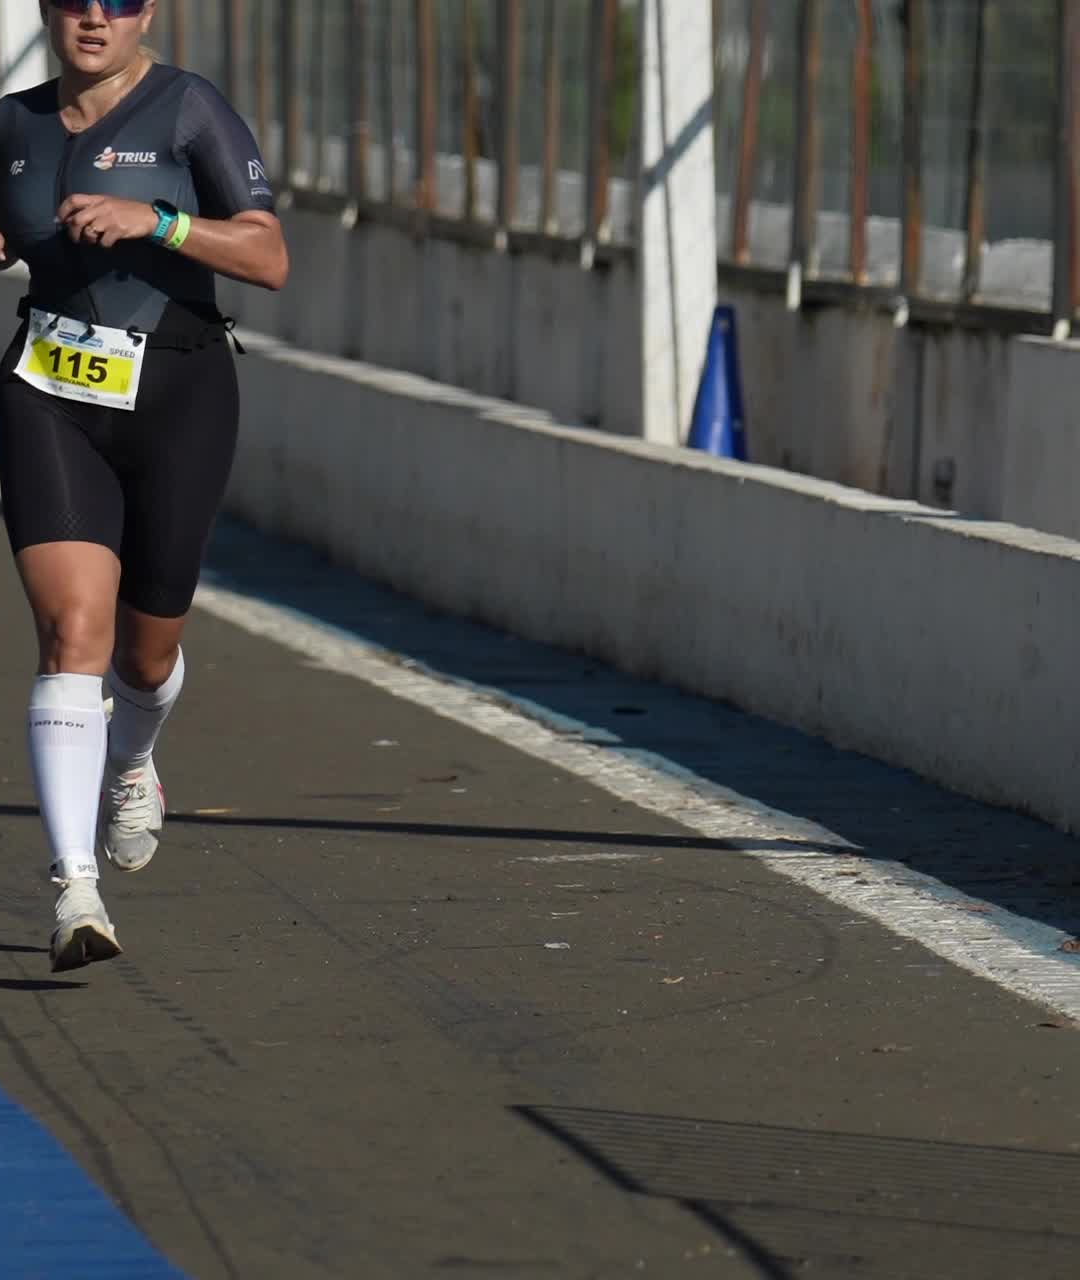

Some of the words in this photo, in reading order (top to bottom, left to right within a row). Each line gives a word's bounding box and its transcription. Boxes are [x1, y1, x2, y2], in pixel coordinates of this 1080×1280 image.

[116, 152, 157, 163] TRIUS
[109, 348, 135, 359] SPEED
[48, 346, 109, 384] 115
